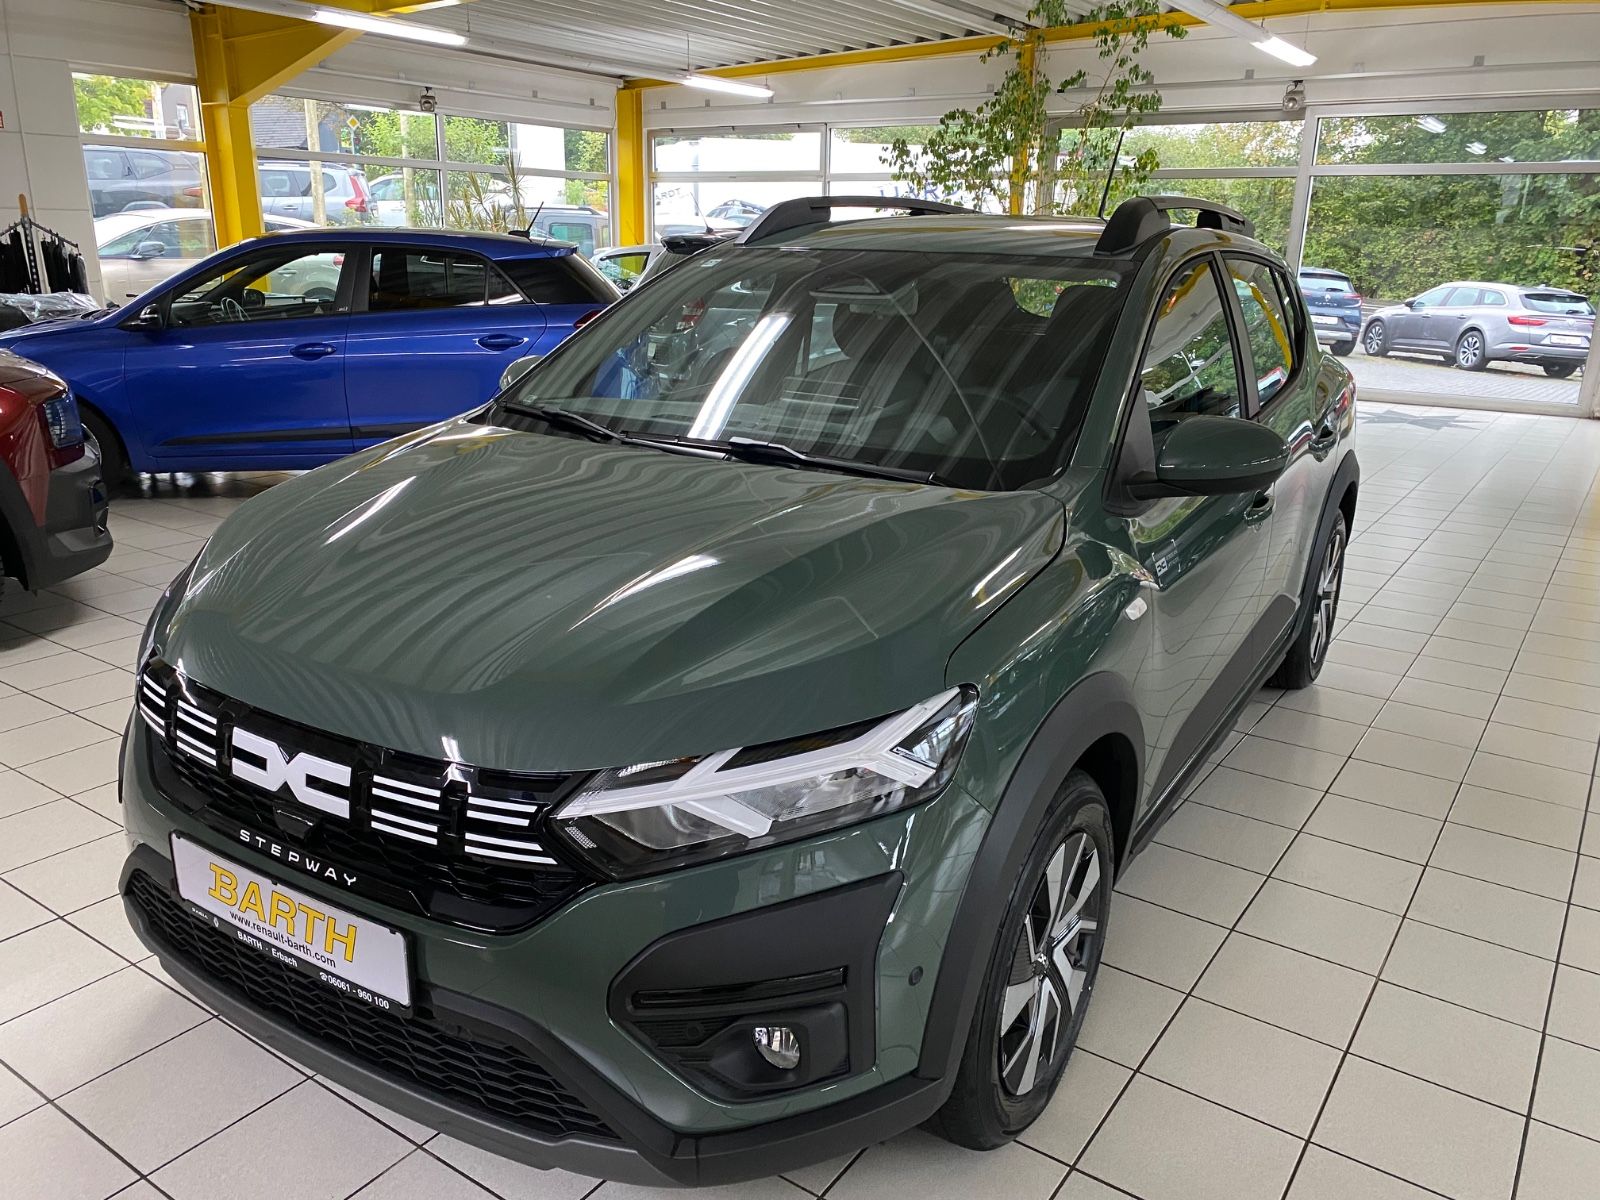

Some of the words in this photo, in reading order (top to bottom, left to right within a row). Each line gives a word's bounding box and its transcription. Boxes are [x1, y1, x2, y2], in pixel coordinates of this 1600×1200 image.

[239, 829, 357, 886] STEPWAY
[208, 863, 358, 962] BARTH
[229, 910, 337, 968] www.renault-barth.com
[237, 930, 263, 951] BARTH
[271, 948, 298, 967] Erbach
[327, 975, 351, 992] 06061
[357, 988, 372, 1002] 960
[374, 996, 390, 1010] 100
